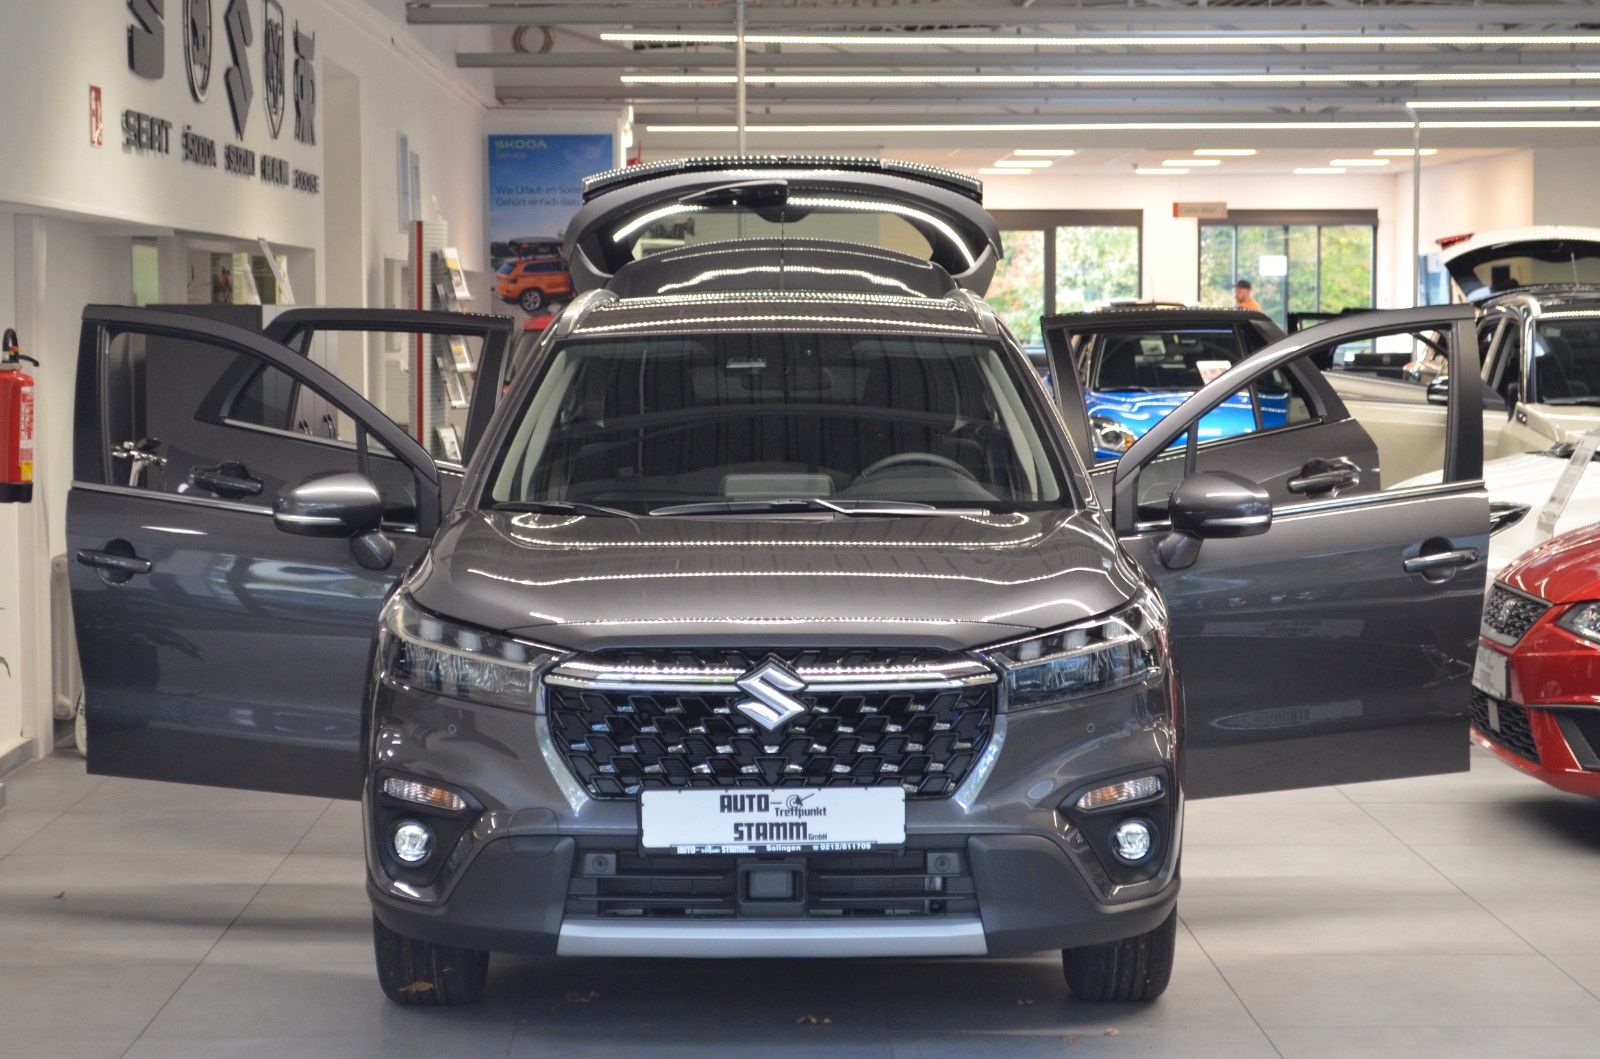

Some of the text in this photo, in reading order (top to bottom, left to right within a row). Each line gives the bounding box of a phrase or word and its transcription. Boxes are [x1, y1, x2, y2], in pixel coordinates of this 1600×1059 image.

[122, 109, 172, 154] SEAT
[225, 144, 256, 177] SUZUKI
[775, 806, 828, 818] Treffpunkt
[733, 821, 828, 841] STAMM GmbH
[765, 845, 802, 853] Solingen
